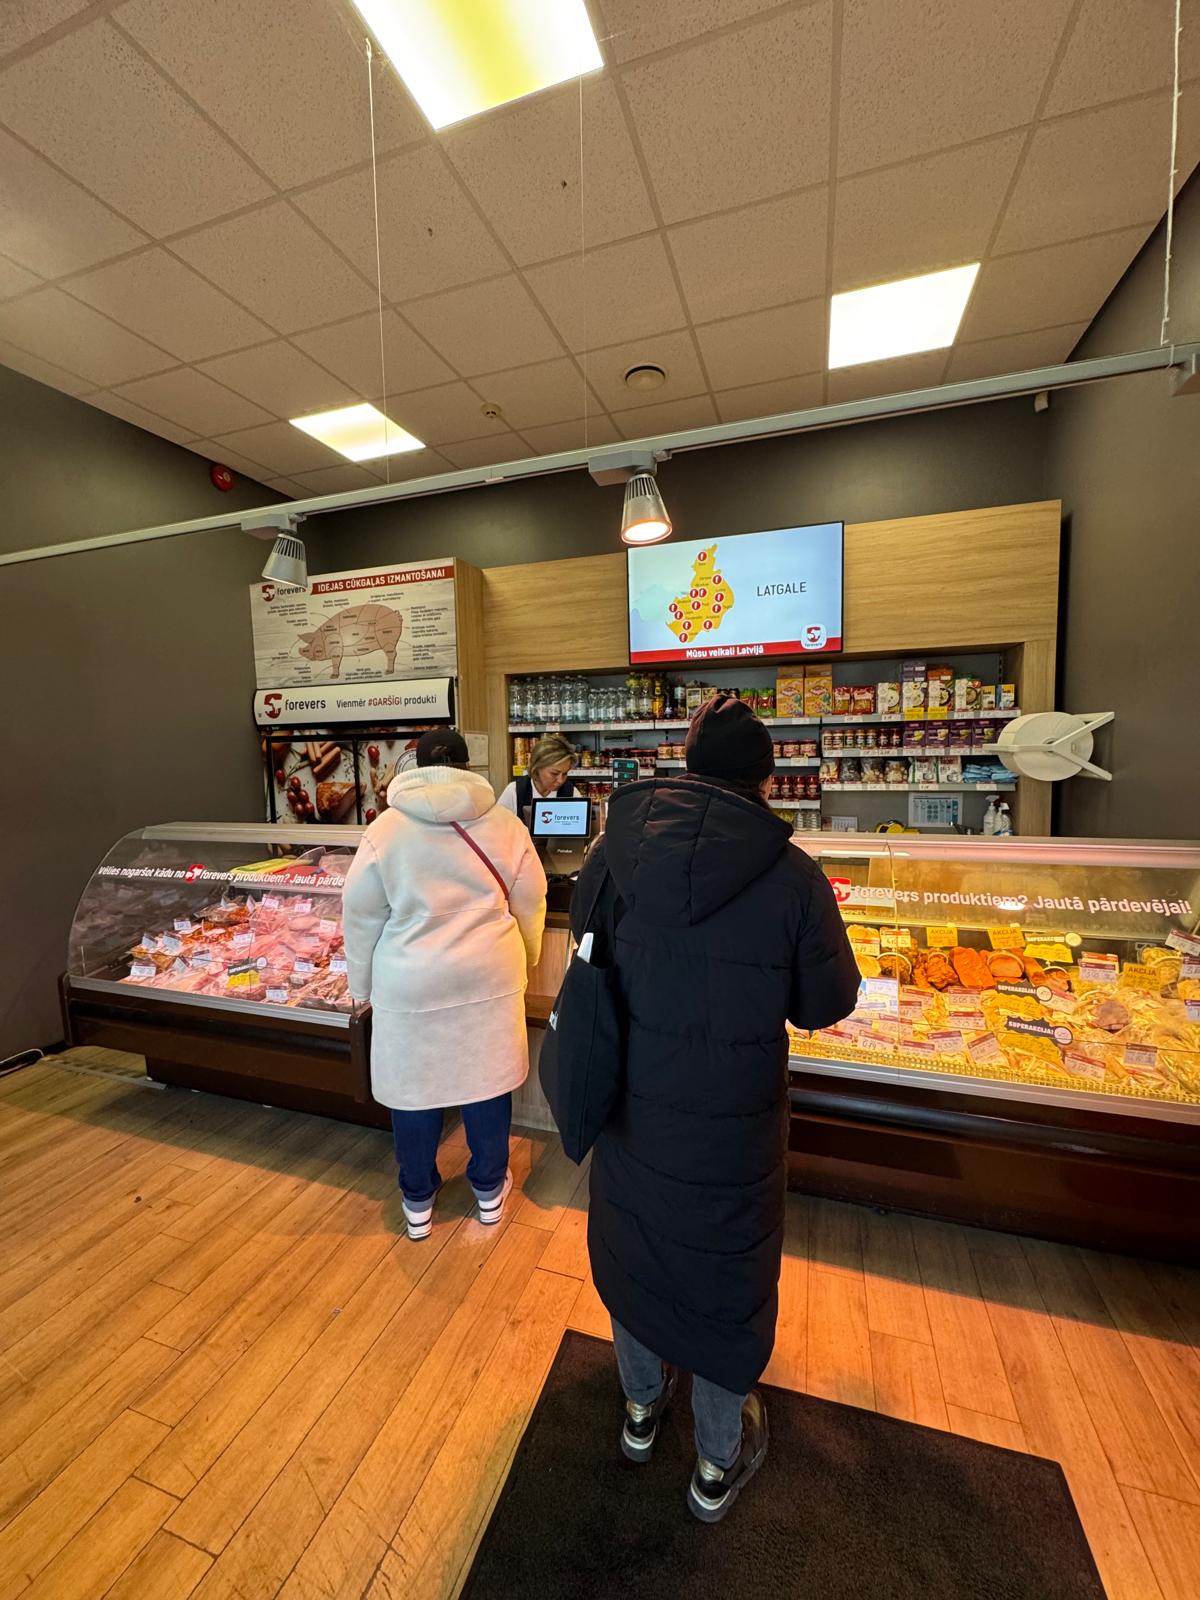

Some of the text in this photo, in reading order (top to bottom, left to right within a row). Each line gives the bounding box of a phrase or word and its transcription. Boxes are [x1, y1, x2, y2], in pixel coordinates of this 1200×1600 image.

[318, 569, 445, 592] IDEJAS CŪKGAĻAS IZMANTOŠANAI
[277, 587, 306, 596] forevers
[756, 581, 807, 597] LATGALE
[686, 649, 707, 658] Mūsu
[736, 645, 764, 656] Latvijā
[285, 699, 326, 711] forevers
[336, 699, 367, 709] Vienmēr
[404, 695, 437, 707] produkti
[98, 866, 121, 875] Vēlies
[120, 867, 153, 878] nogaršot
[153, 867, 173, 878] kādu
[200, 869, 234, 880] forevers
[234, 871, 290, 883] produktiem?
[290, 873, 316, 885] Jautā
[854, 885, 1192, 917] forevers produktiem? Jautā pārdevējai!
[1128, 966, 1157, 976] AKCIJA
